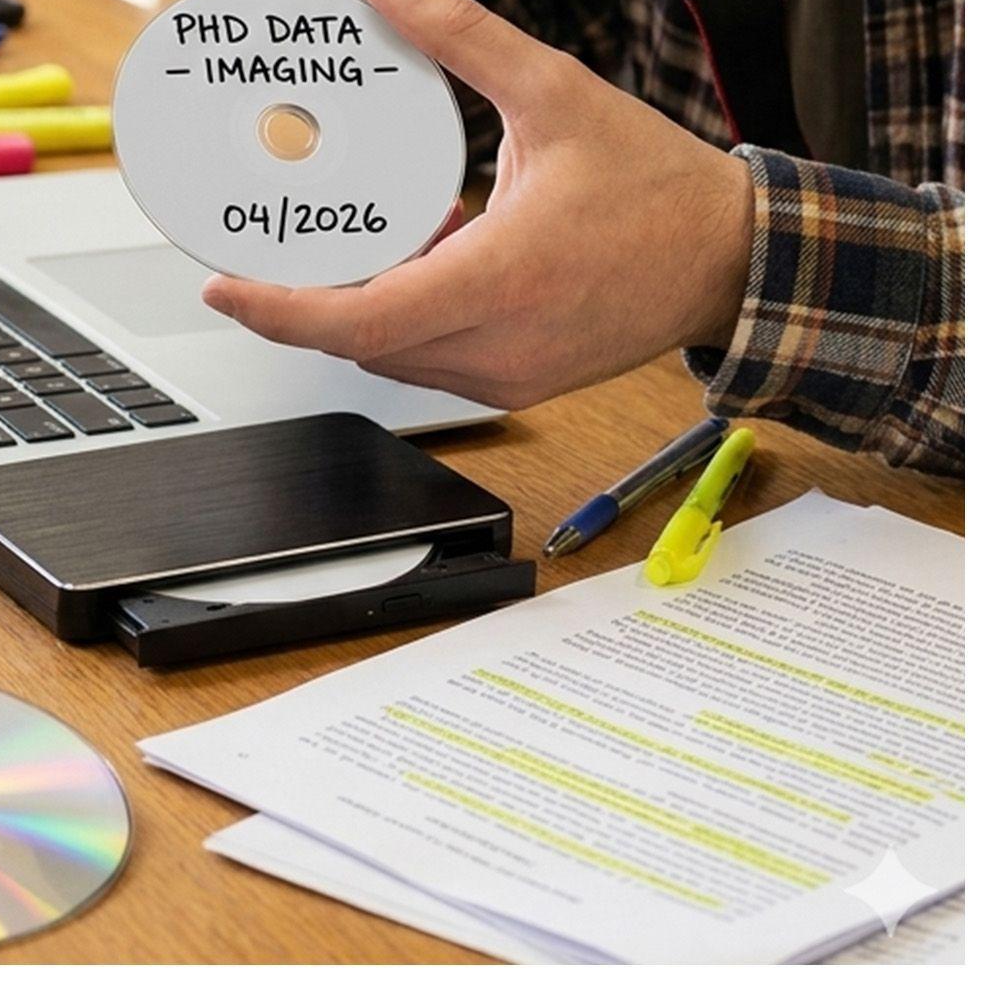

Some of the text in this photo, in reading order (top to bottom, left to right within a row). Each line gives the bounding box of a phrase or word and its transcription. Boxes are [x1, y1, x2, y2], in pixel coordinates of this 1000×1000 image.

[172, 13, 363, 45] PHD DATA
[204, 55, 364, 87] IMAGING
[222, 196, 388, 244] 04/2026
